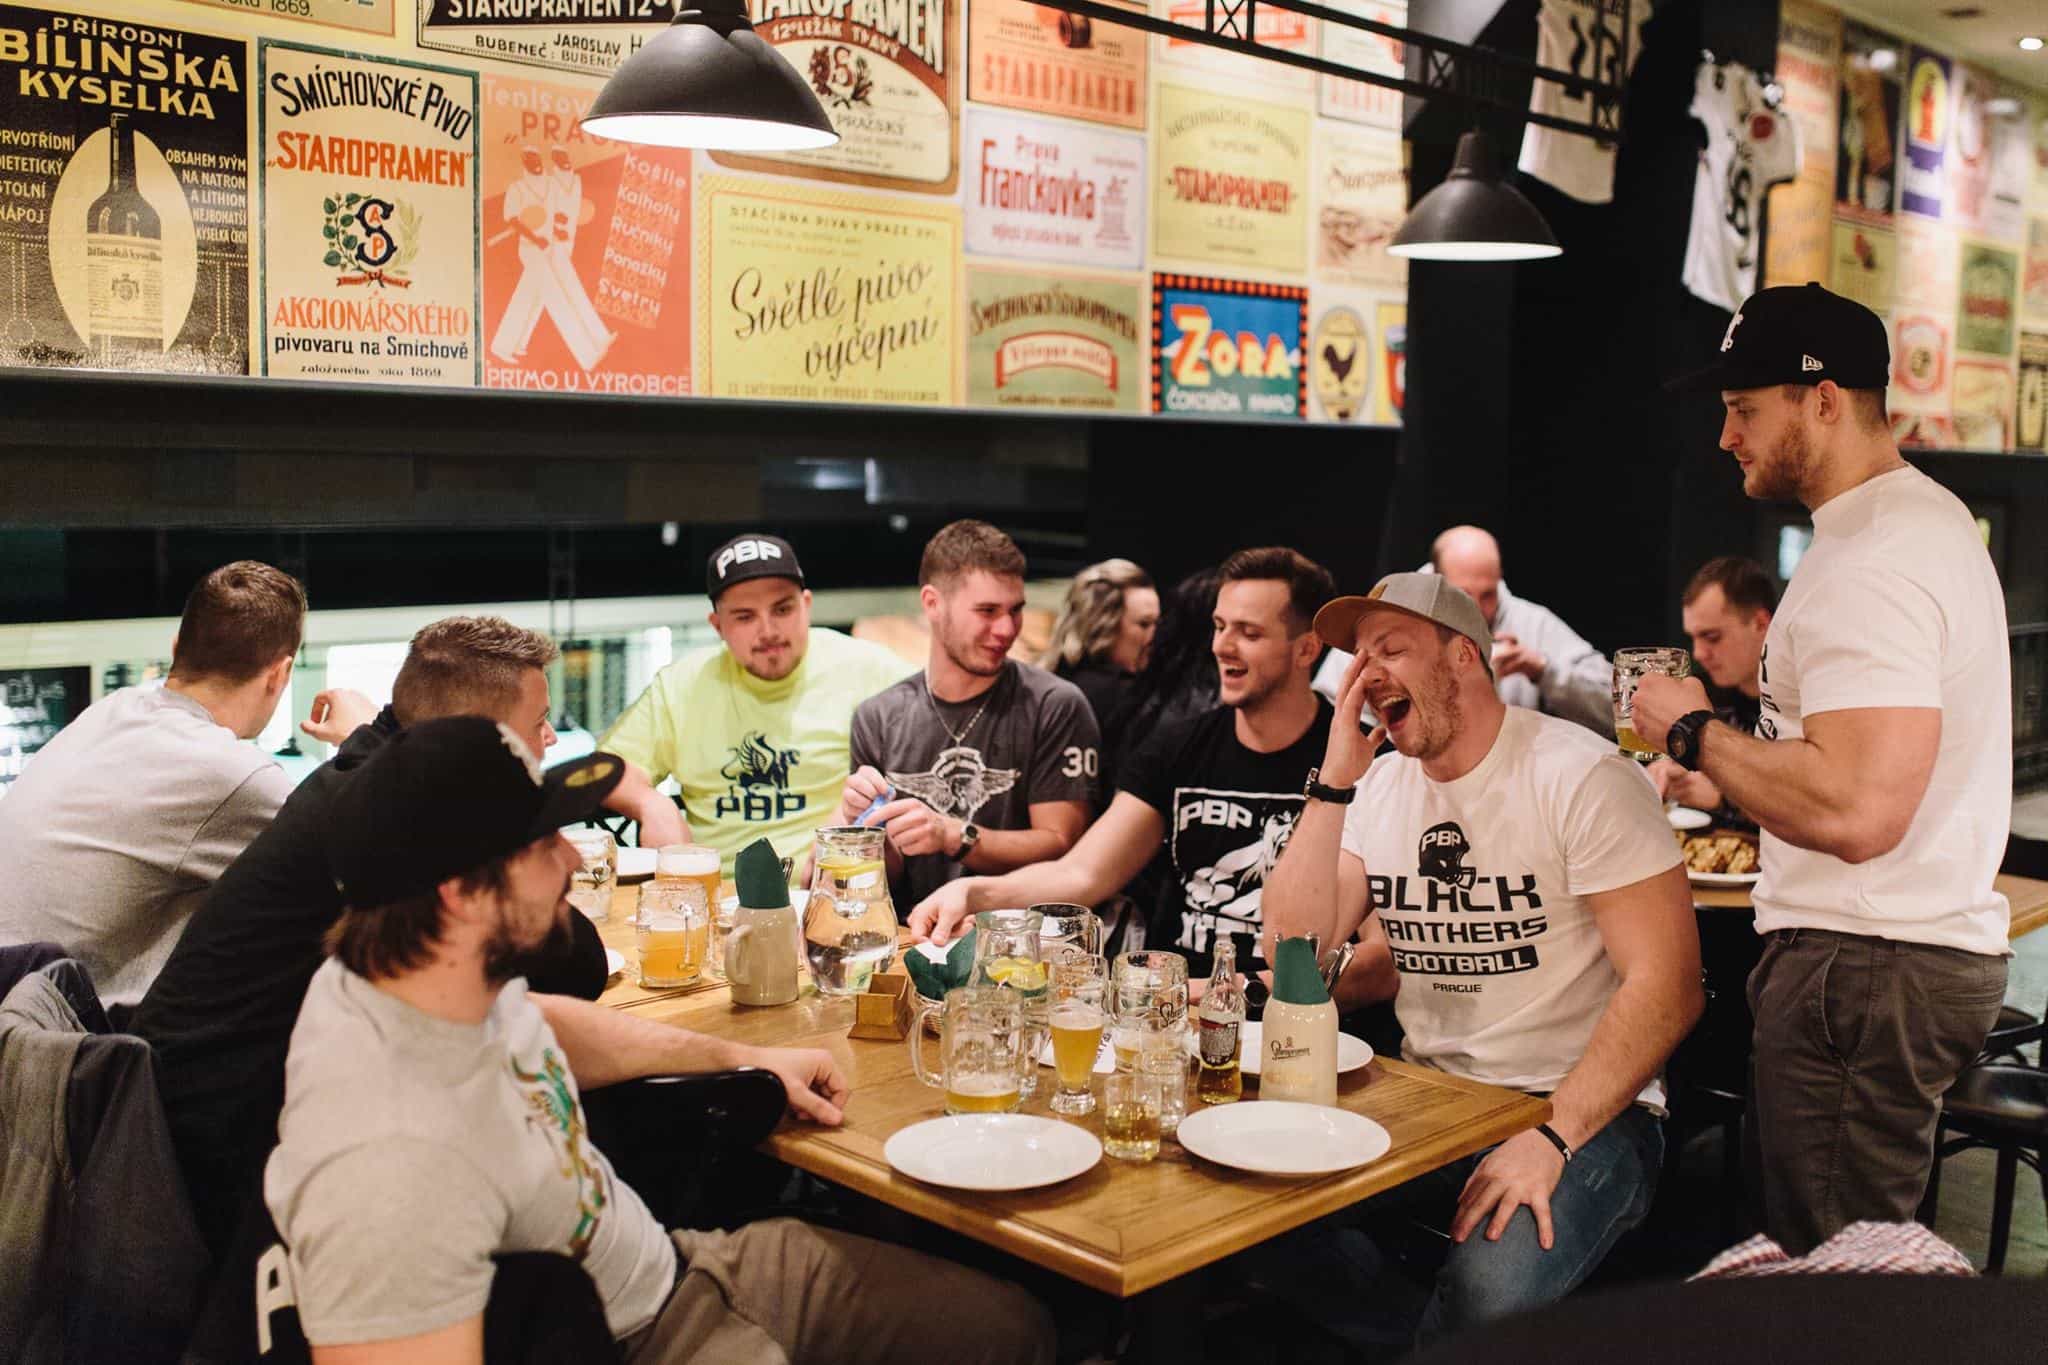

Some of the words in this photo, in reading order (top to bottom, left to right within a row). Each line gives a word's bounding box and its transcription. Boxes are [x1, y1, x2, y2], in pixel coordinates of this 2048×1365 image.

[53, 16, 183, 49] PŘÍRODNÍ
[553, 33, 621, 55] JAROSLAV
[0, 27, 240, 93] BÍLINSKÁ
[20, 68, 215, 120] KYSELKA
[0, 129, 75, 151] RVOTŘÍDNÍ
[166, 148, 216, 168] OBSAHEM
[182, 169, 199, 184] NA
[202, 171, 246, 190] NATRON
[731, 265, 846, 342] Světlé
[854, 258, 935, 324] pivo
[275, 332, 354, 355] pivovaru
[360, 340, 380, 356] na
[1171, 304, 1293, 387] ZORA
[564, 370, 580, 393] U
[716, 540, 782, 579] PBP
[1062, 746, 1099, 778] 30
[1179, 799, 1253, 832] PBP
[1379, 915, 1548, 943] ANTHERS
[1394, 950, 1532, 974] FOOTBALL
[1432, 982, 1483, 993] PRAGUE
